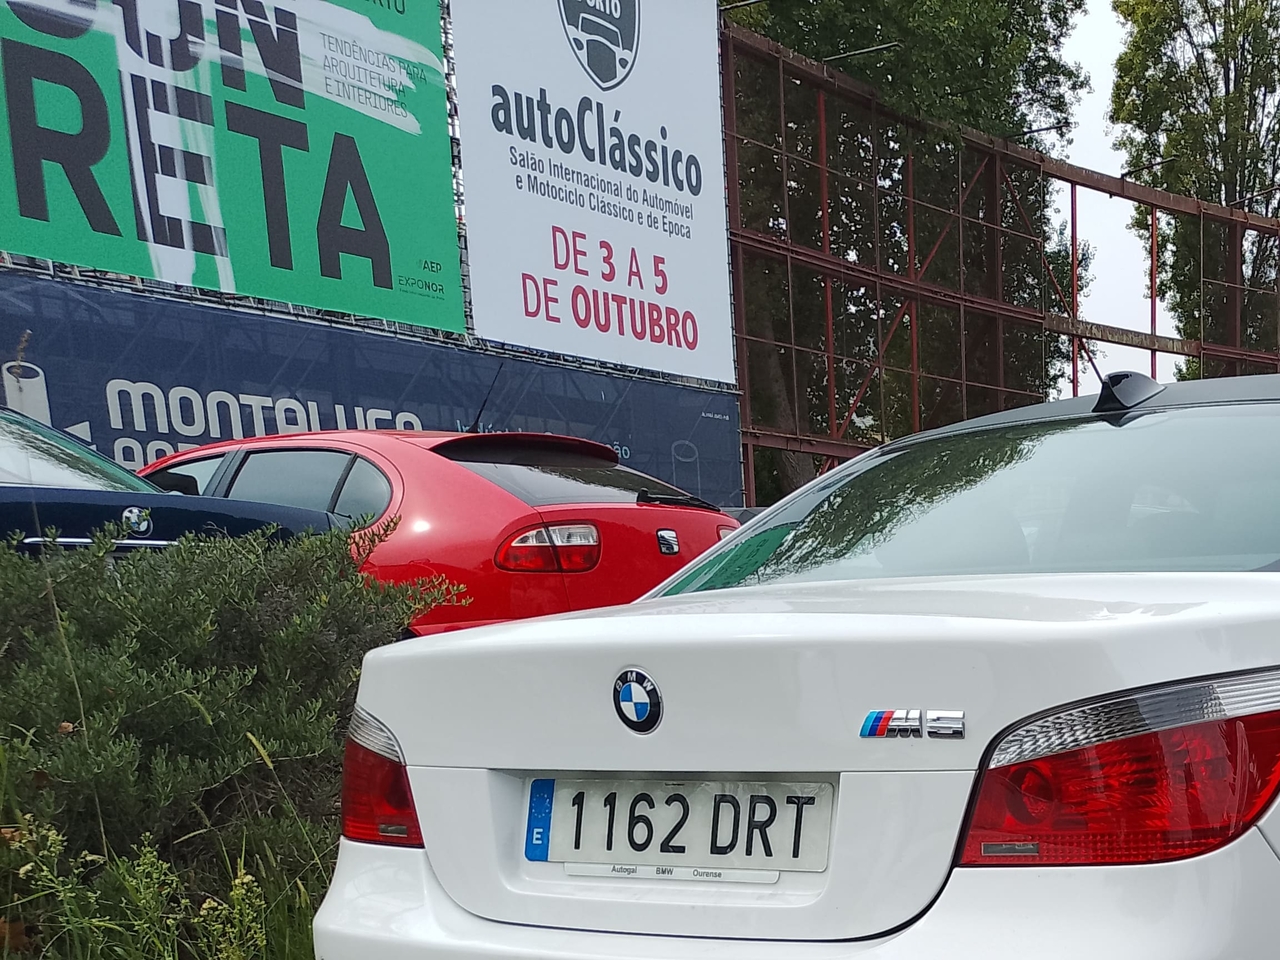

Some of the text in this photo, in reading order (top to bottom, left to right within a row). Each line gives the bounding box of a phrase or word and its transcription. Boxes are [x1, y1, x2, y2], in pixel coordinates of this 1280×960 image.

[319, 31, 427, 85] TENDÊNCIAS PARA
[323, 54, 406, 97] ARQUITETURA
[325, 76, 408, 118] E INTERIORES
[491, 84, 702, 197] autoClássico
[509, 146, 694, 221] Salão Internacional do Automóvel
[516, 173, 692, 240] e Motociclo Clássico e de Época
[423, 260, 442, 273] AEP
[552, 225, 668, 296] DE 3 A 5
[398, 275, 445, 295] EXPONOR
[522, 272, 699, 351] DE OUTUBRO
[615, 671, 655, 692] BMW
[532, 828, 544, 845] E
[571, 791, 816, 859] 1162 DRT
[611, 864, 723, 879] Autogal BMW Ourense
